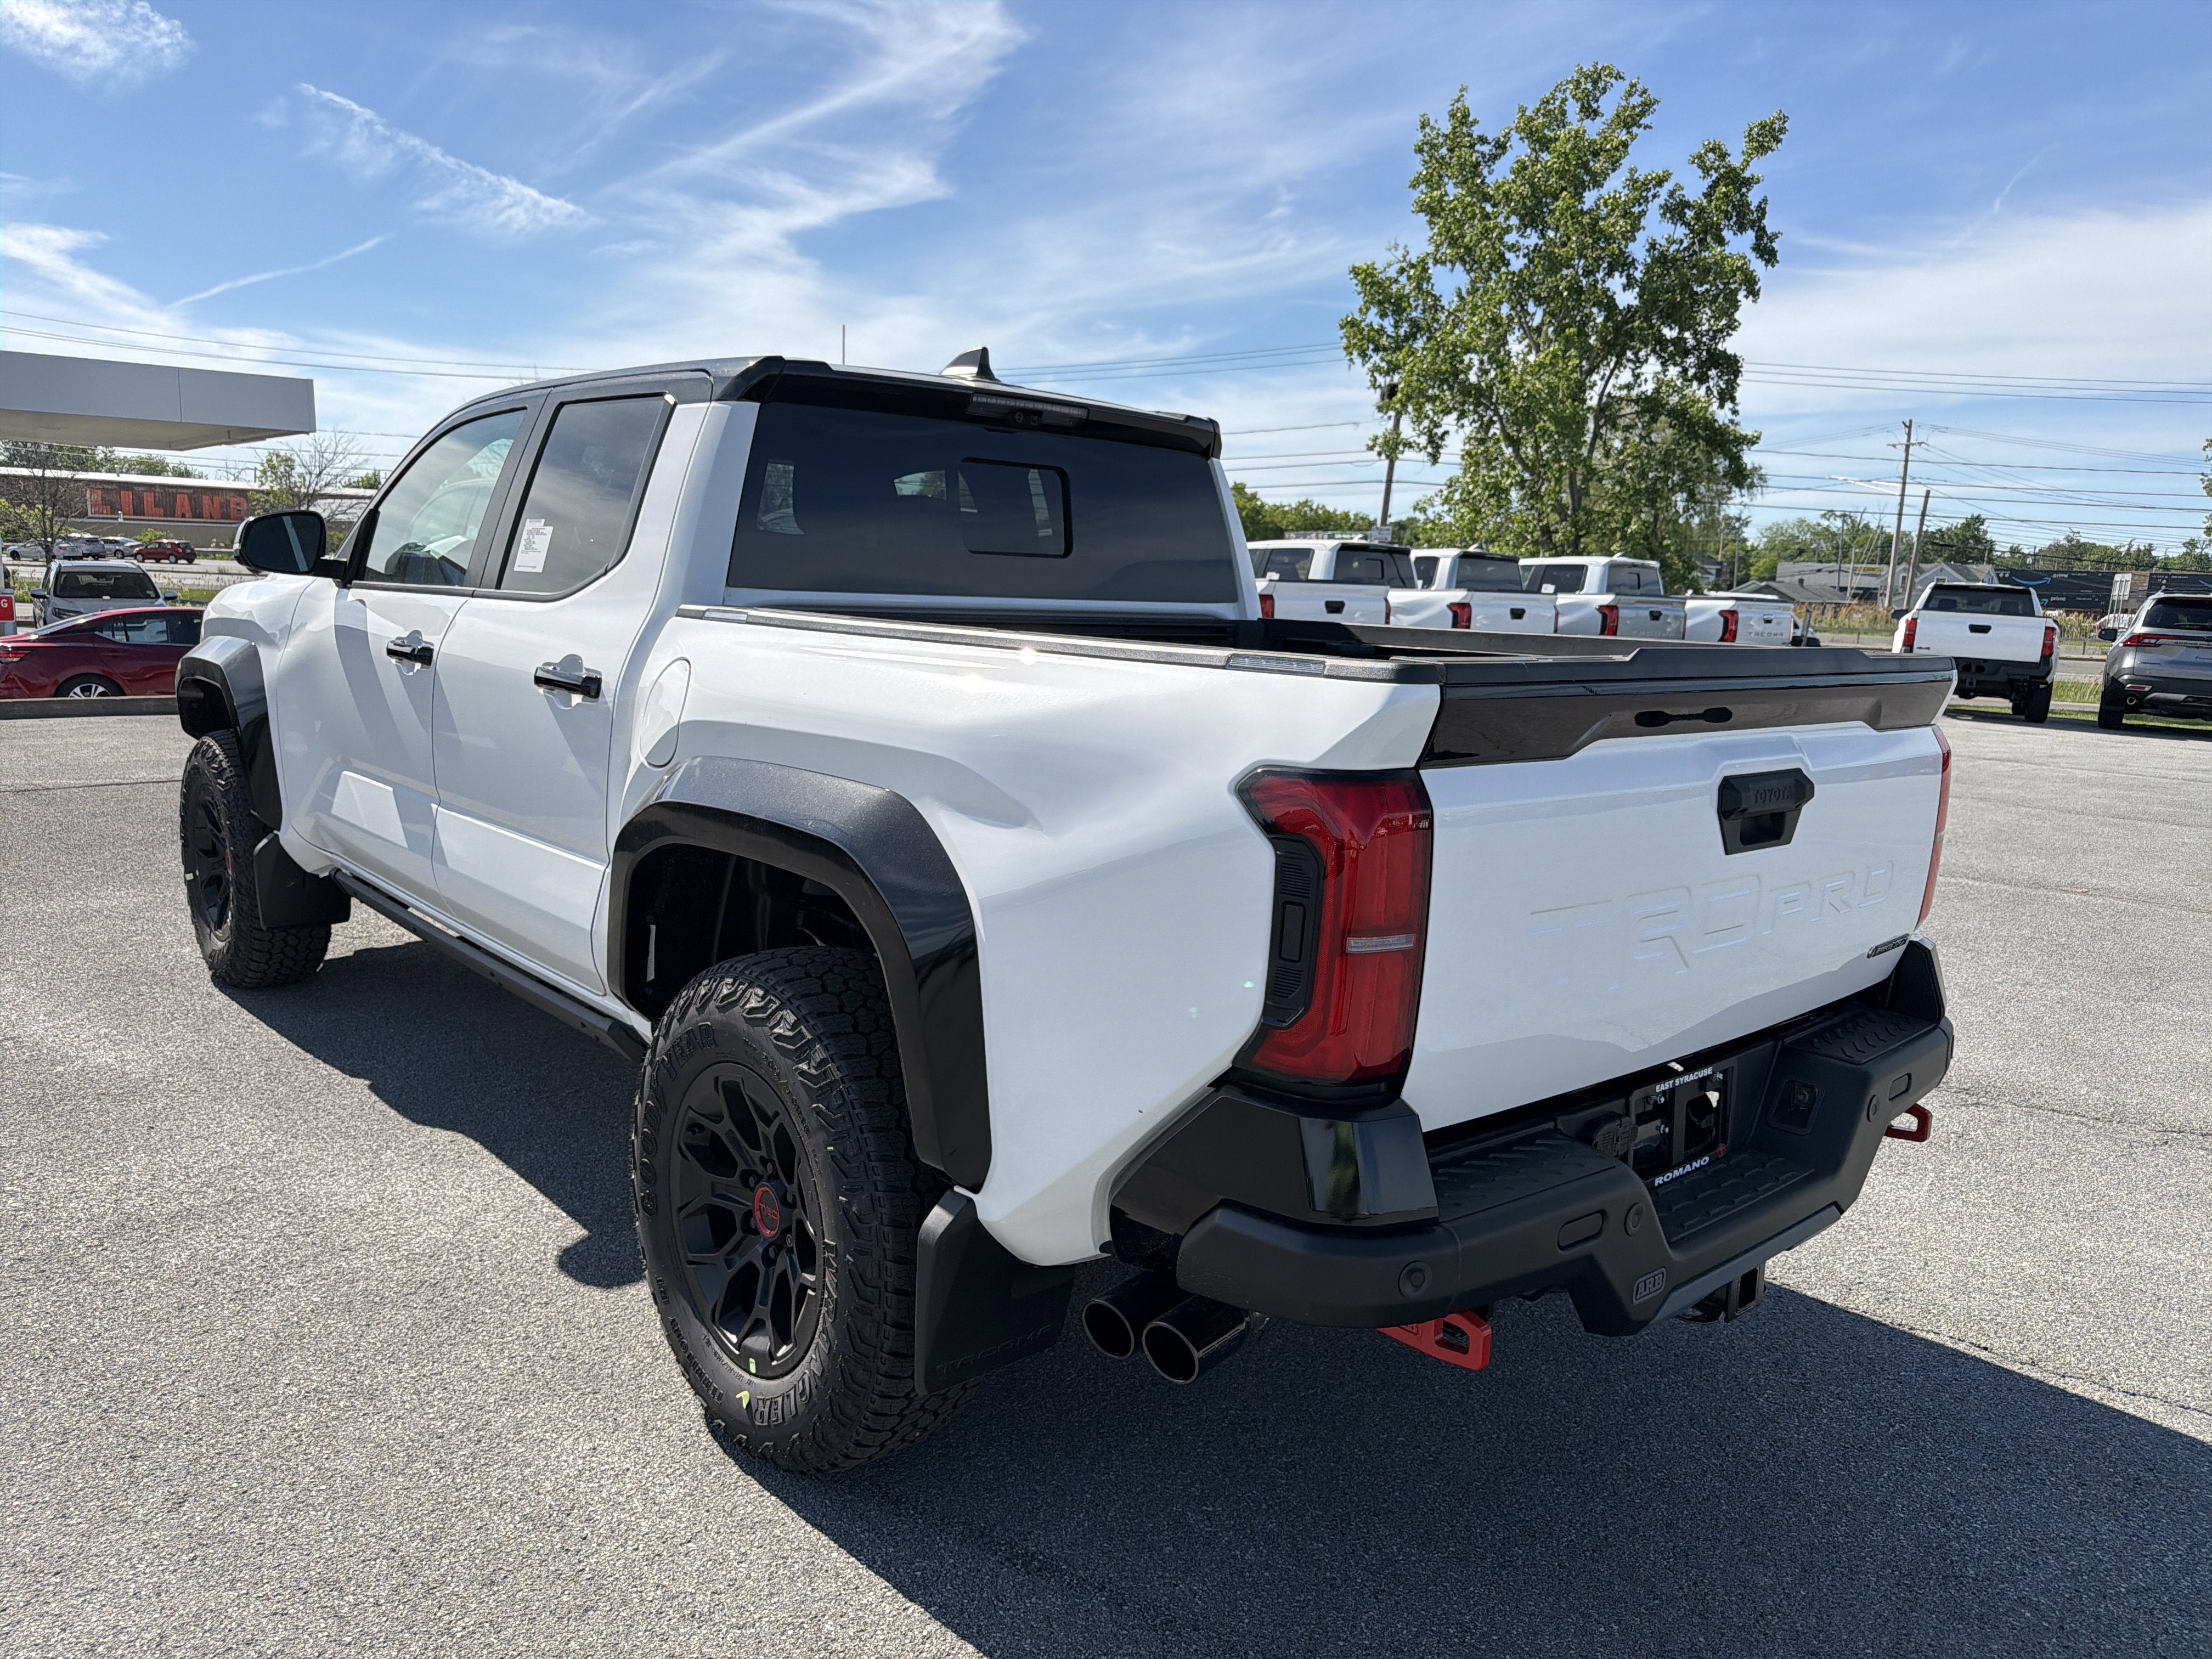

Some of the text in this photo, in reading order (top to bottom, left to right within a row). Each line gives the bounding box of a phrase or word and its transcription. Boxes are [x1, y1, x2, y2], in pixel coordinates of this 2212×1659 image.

[1752, 785, 1793, 804] TOYOTA
[1762, 860, 1894, 935] PRO
[1656, 1066, 1713, 1093] EAST SYRACUSE
[1654, 1156, 1709, 1186] ROMANO
[759, 1202, 778, 1220] TRD
[1636, 1273, 1663, 1300] ARB
